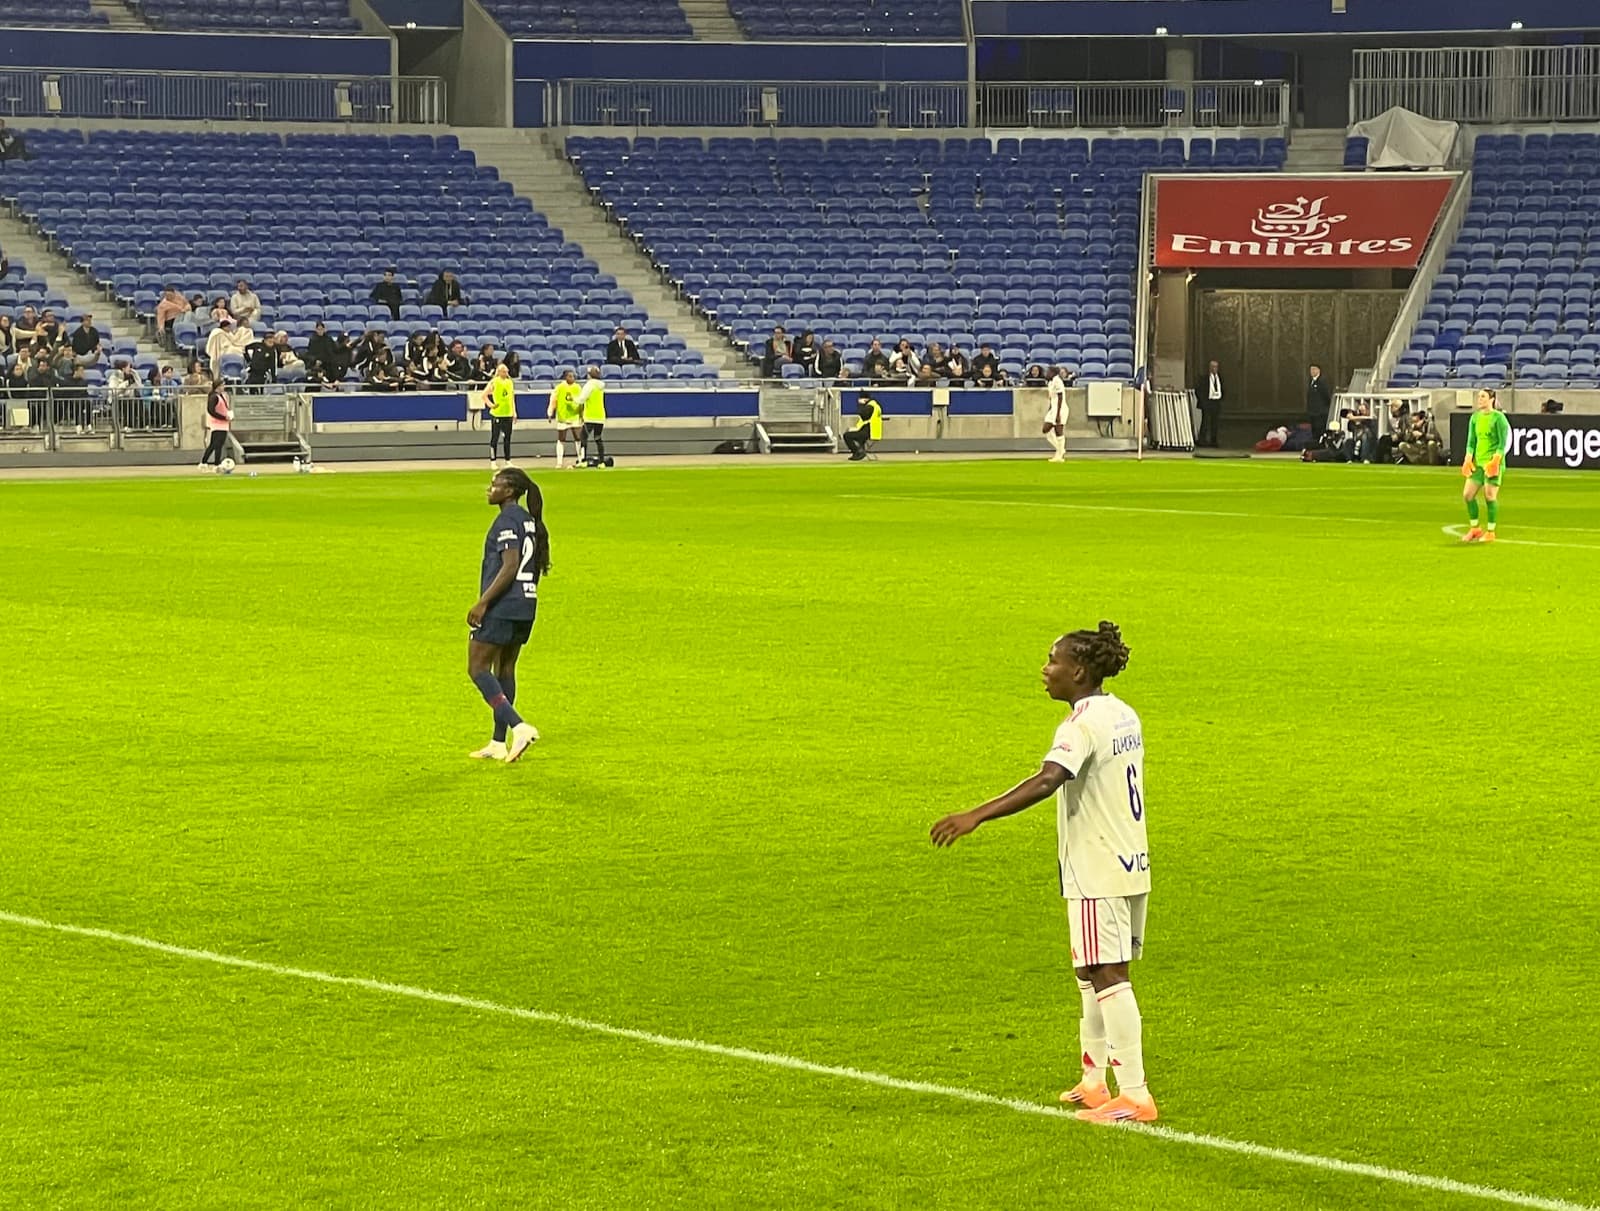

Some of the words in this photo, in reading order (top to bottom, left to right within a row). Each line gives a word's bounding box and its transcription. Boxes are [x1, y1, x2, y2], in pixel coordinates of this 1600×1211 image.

[1171, 234, 1413, 256] Emirates
[1505, 427, 1600, 467] range
[516, 535, 536, 580] 2
[1126, 763, 1142, 822] 6
